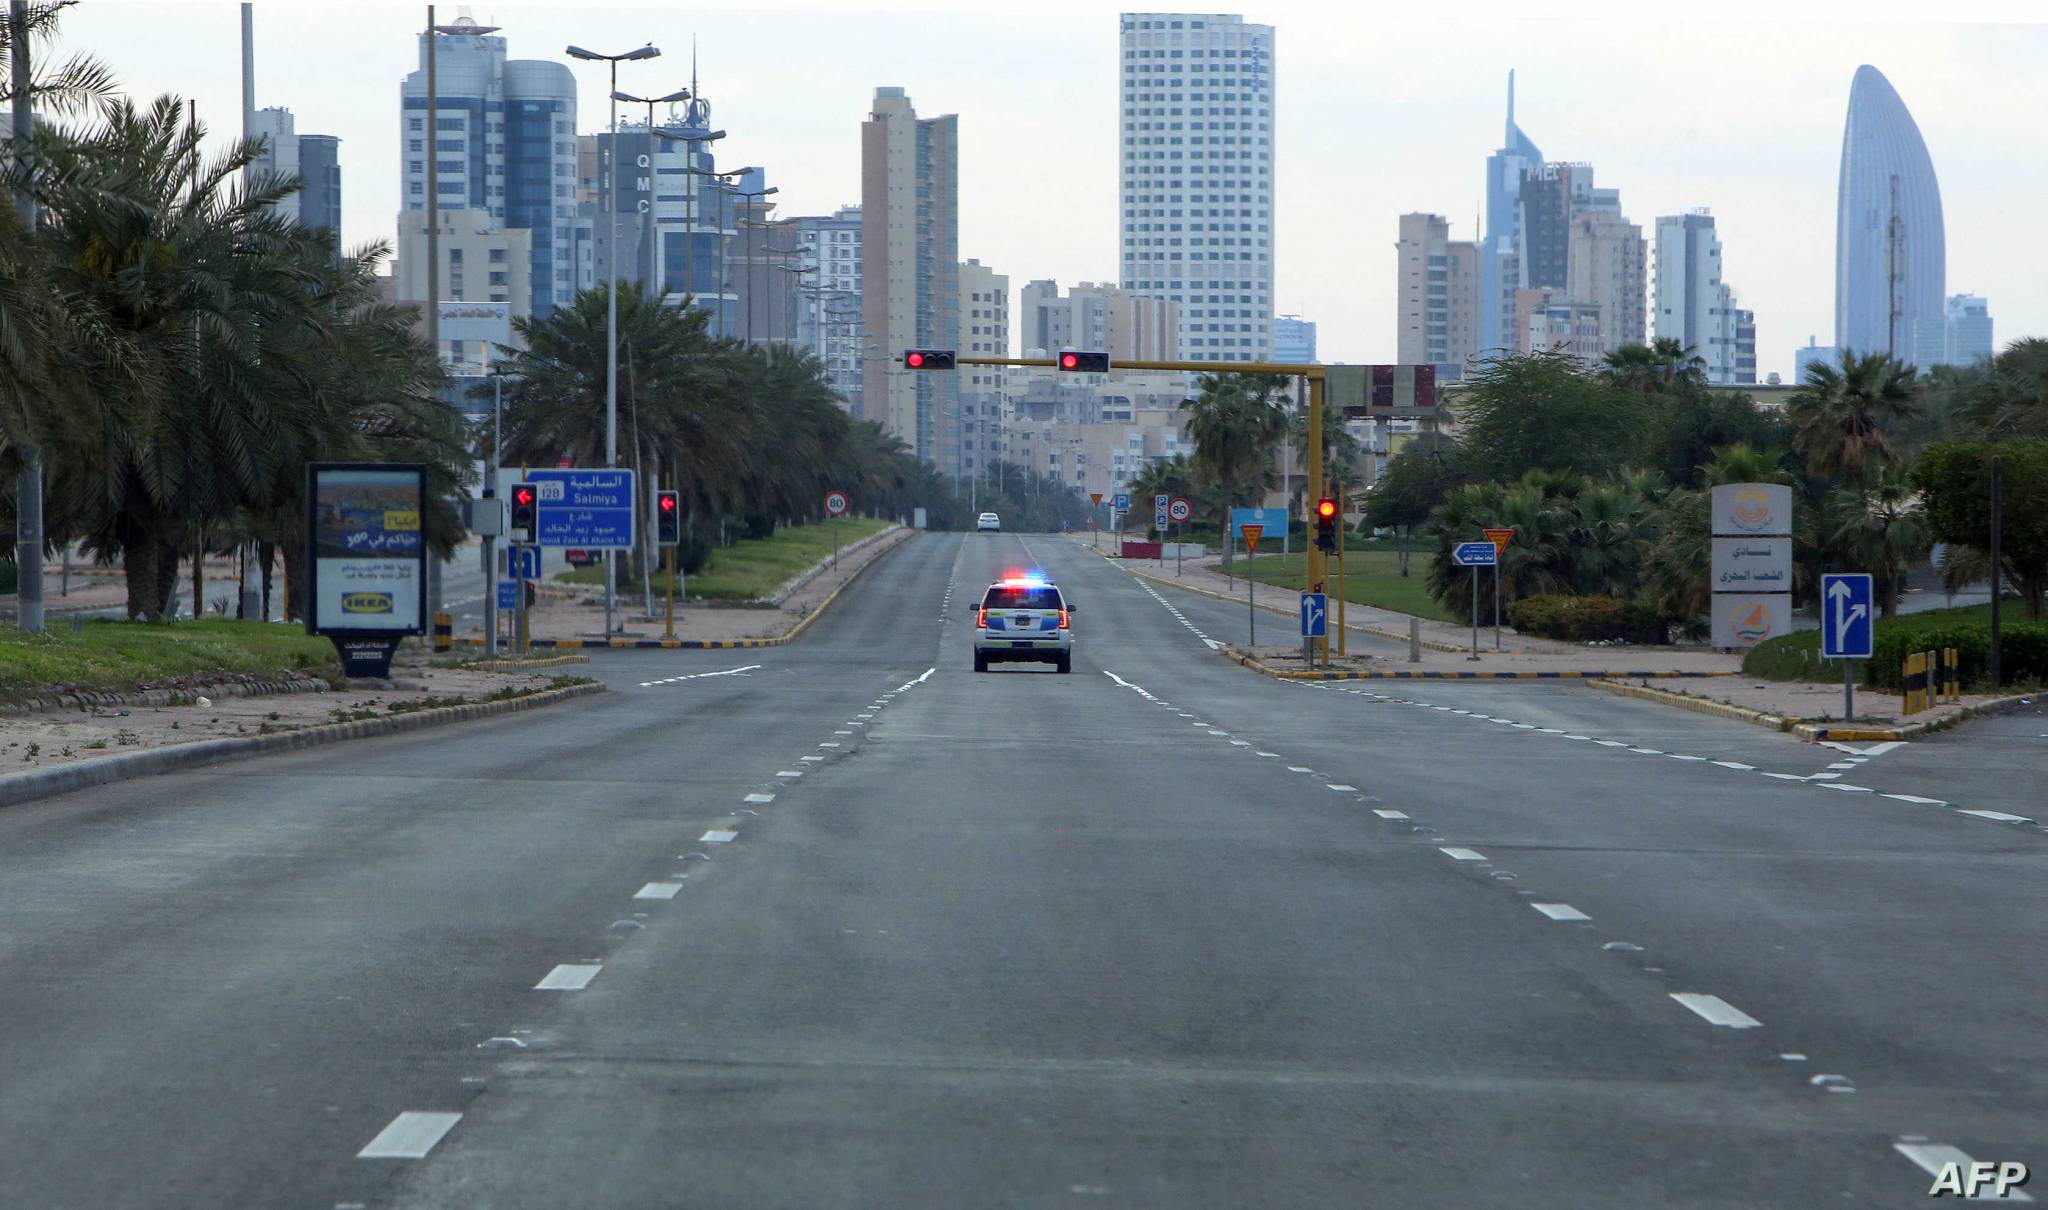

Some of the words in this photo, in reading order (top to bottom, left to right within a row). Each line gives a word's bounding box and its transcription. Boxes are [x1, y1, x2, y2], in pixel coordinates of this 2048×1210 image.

[541, 488, 559, 499] 128
[574, 493, 617, 505] Salmiya
[830, 499, 843, 508] 80
[1117, 495, 1126, 508] P
[1173, 505, 1187, 515] 80
[368, 532, 385, 550] في
[347, 598, 389, 608] IKEA
